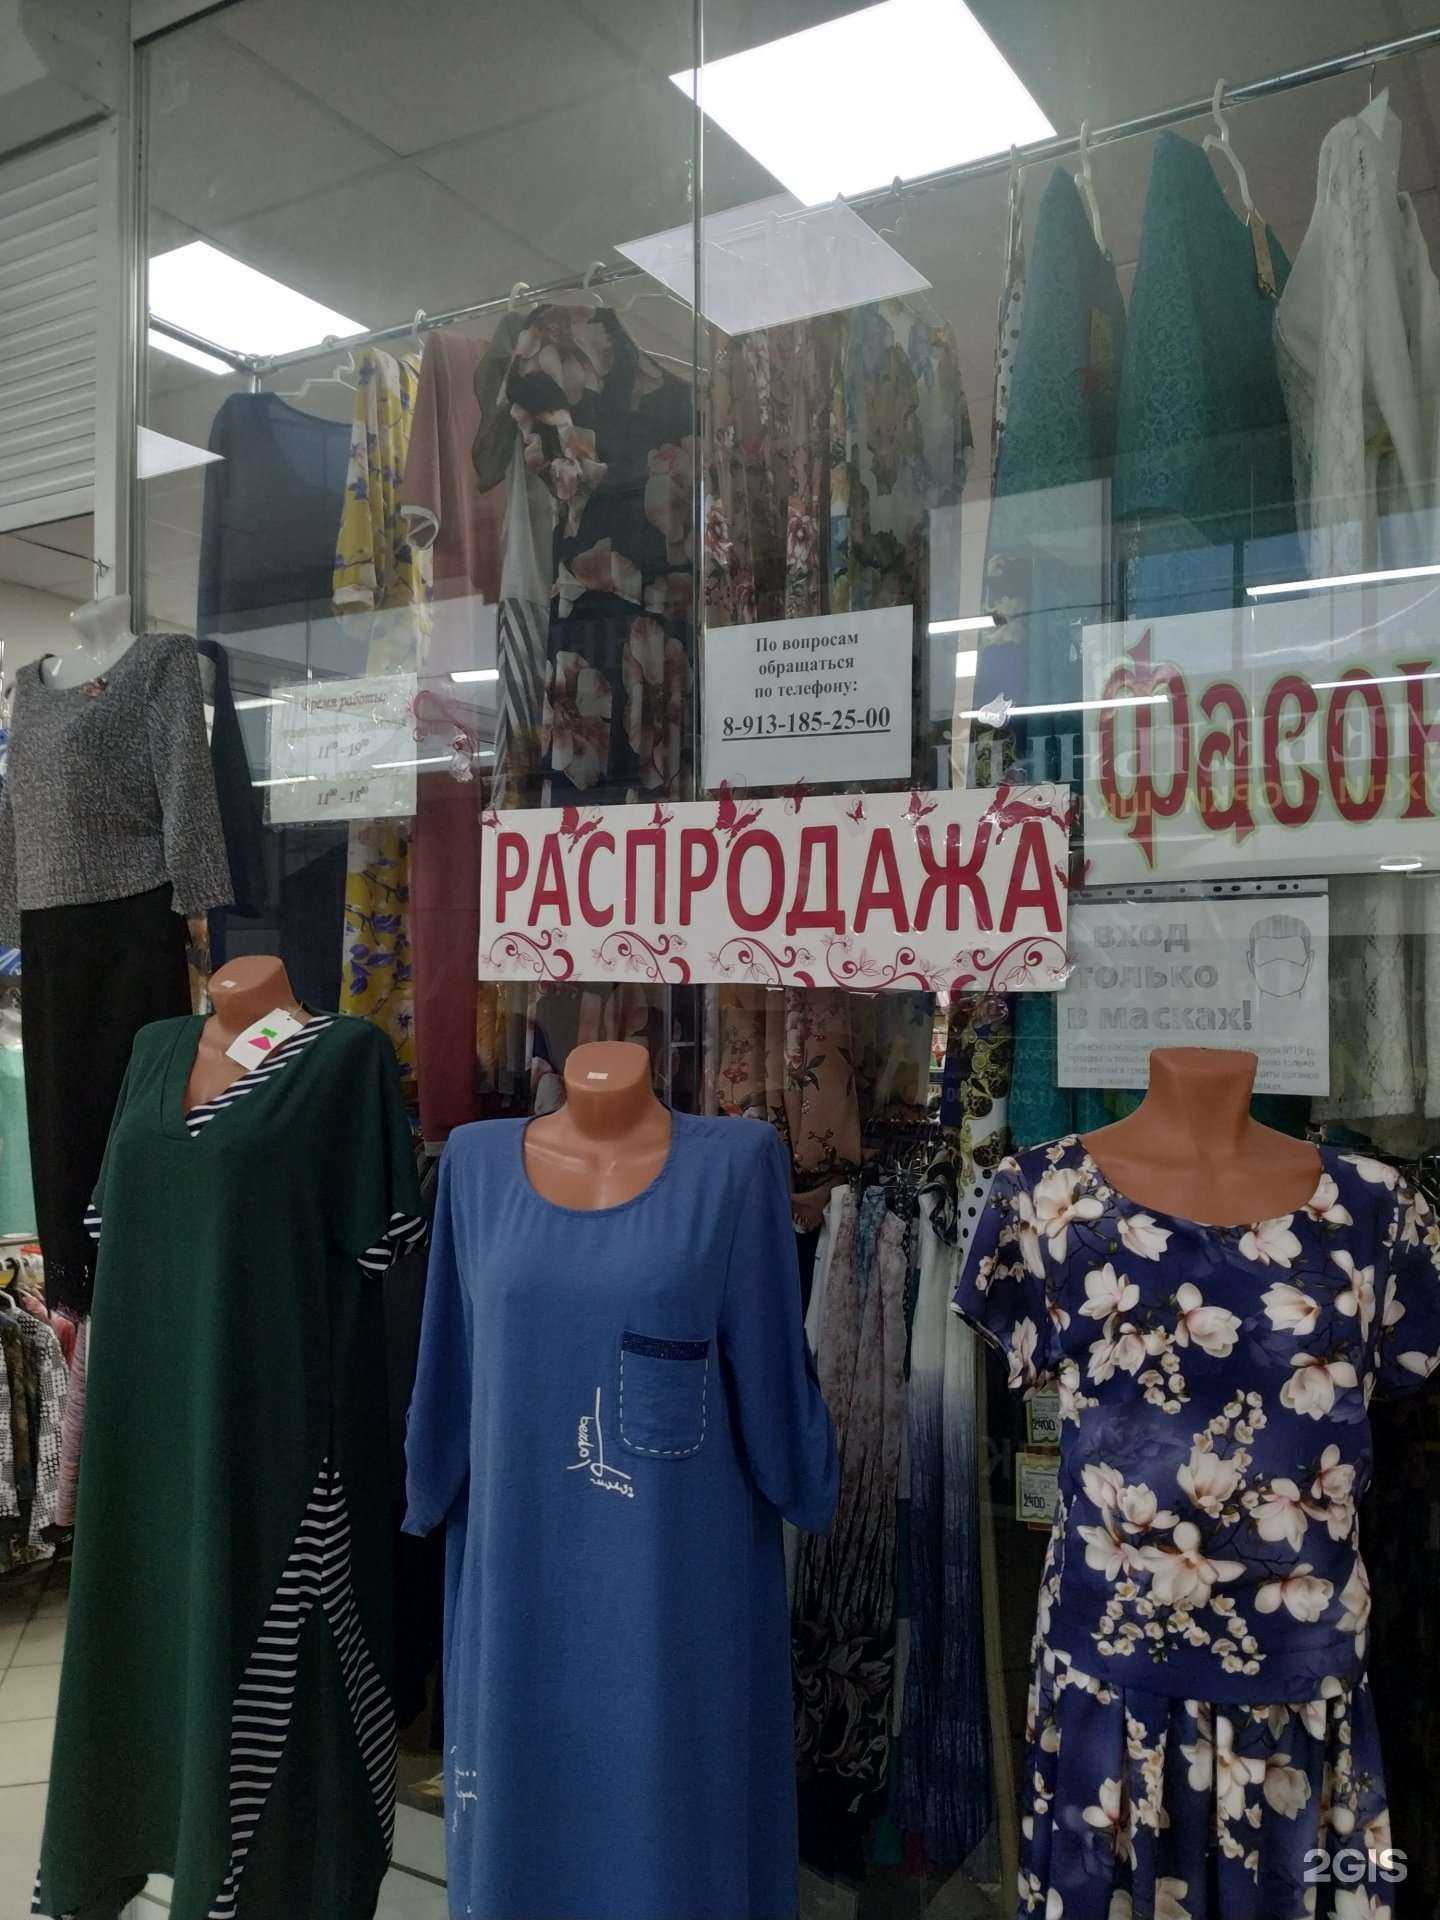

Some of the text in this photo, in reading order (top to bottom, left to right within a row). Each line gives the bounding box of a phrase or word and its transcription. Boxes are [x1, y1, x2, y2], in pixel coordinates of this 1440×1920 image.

[756, 633, 858, 652] По вопросам
[759, 657, 854, 678] обращаться
[754, 680, 858, 699] по телефону:
[722, 707, 891, 738] 8-913-185-25-00
[496, 821, 1063, 937] РАСПРОДАЖА
[1074, 964, 1219, 990] только
[1102, 1000, 1254, 1031] масках!
